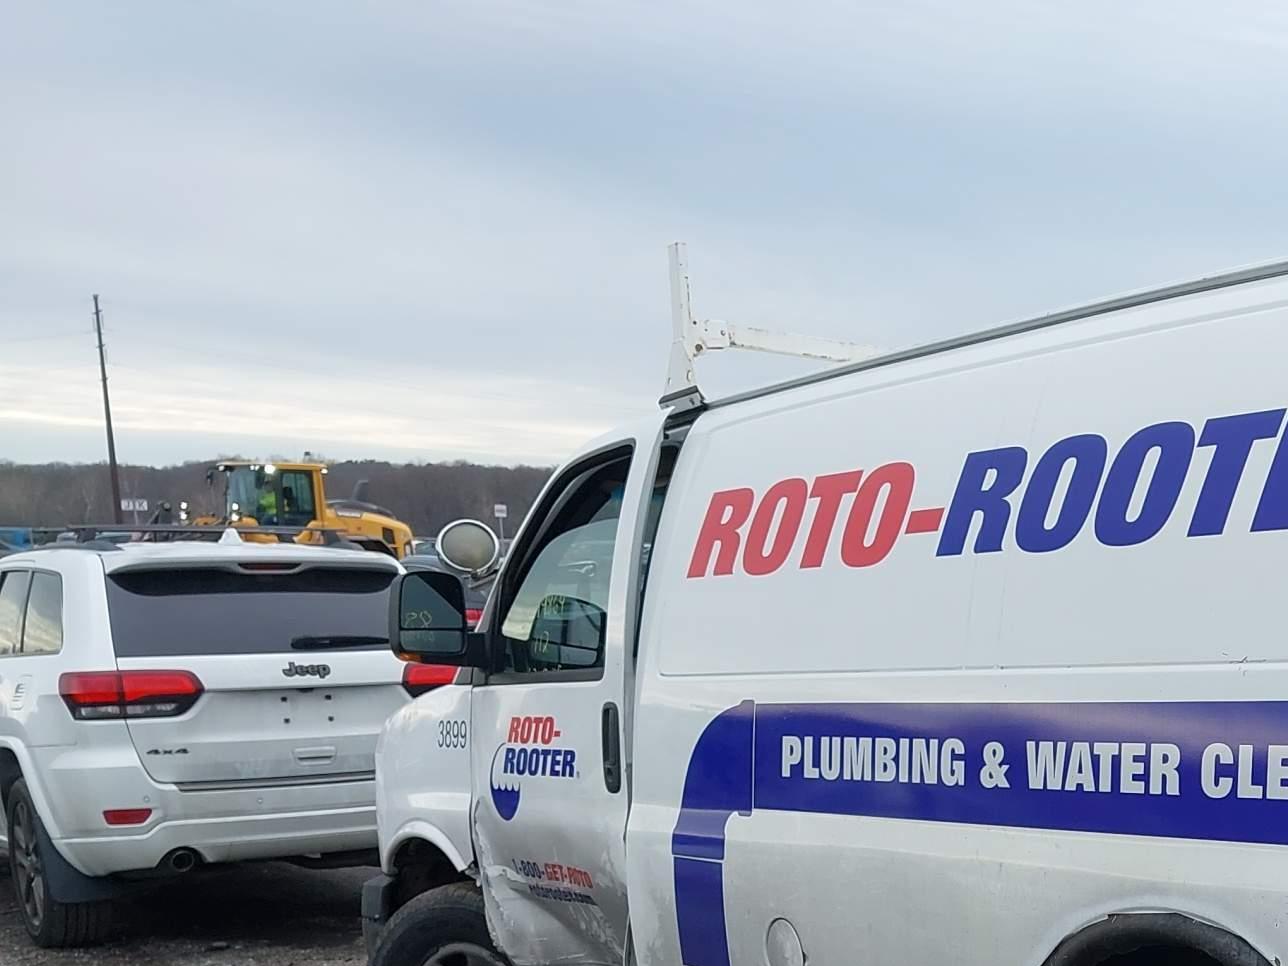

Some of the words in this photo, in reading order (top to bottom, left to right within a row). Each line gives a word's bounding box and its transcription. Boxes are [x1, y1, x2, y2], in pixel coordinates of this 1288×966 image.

[282, 662, 331, 678] Jeep
[438, 720, 467, 748] 3899
[507, 716, 561, 744] ROTO-
[503, 748, 576, 777] ROOTER
[781, 735, 965, 786] PLUMBING
[979, 741, 1011, 788] &
[1025, 741, 1180, 796] WATER
